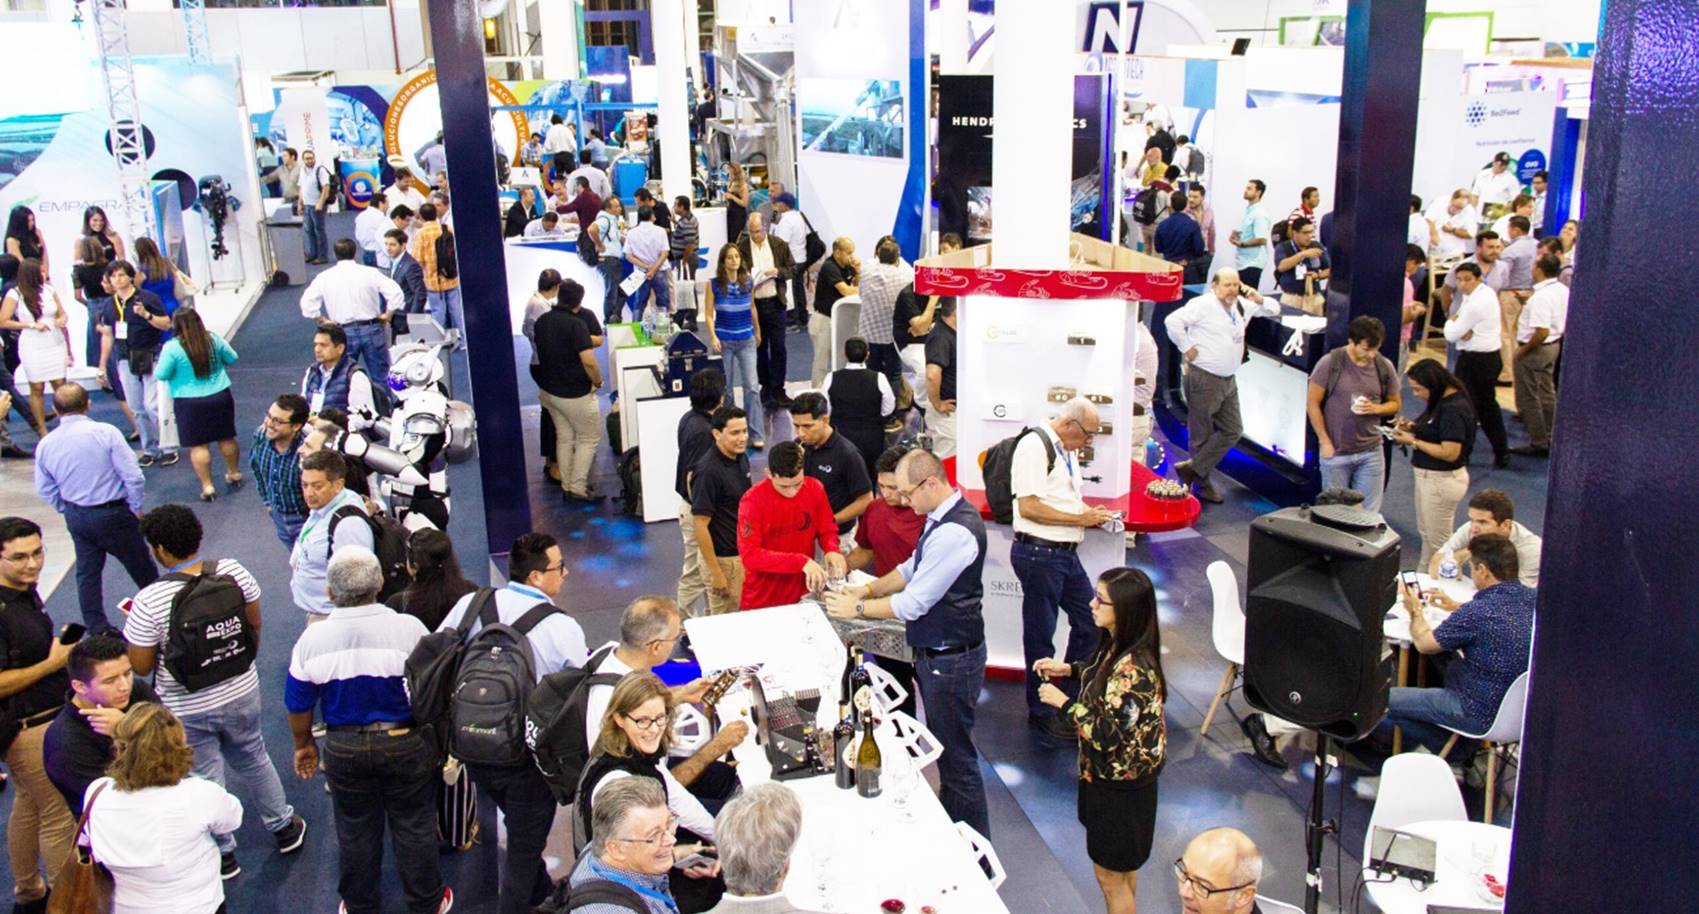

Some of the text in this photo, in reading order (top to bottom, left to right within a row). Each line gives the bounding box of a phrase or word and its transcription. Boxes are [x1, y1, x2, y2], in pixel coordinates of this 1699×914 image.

[1073, 118, 1087, 129] CS
[991, 580, 1021, 593] SKRE
[206, 616, 240, 633] AQUA
